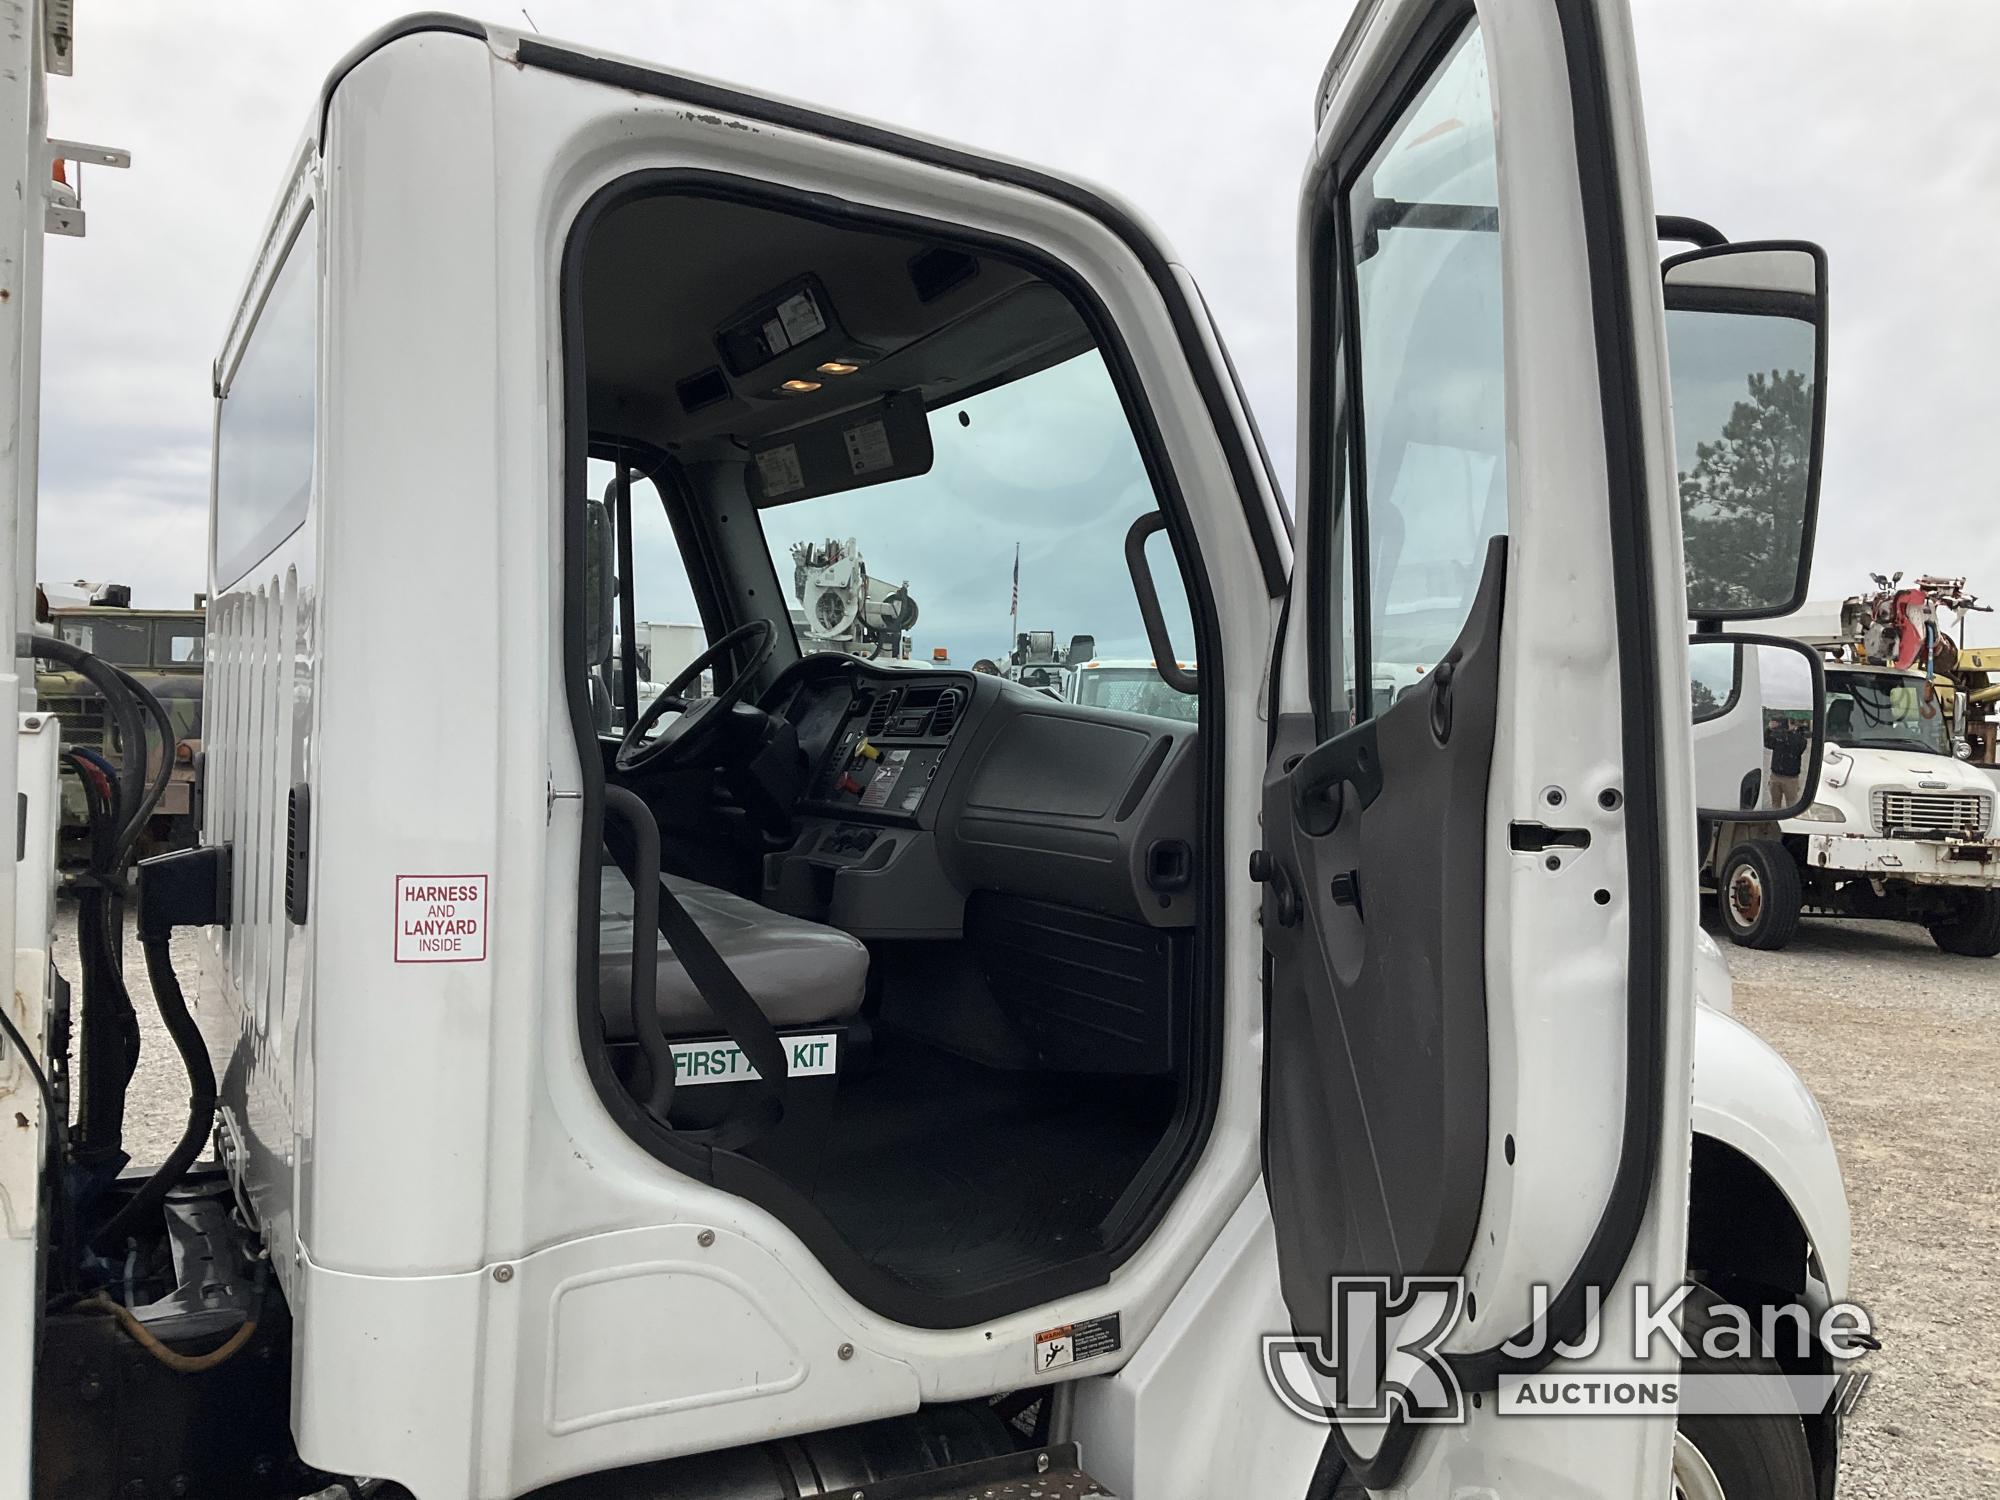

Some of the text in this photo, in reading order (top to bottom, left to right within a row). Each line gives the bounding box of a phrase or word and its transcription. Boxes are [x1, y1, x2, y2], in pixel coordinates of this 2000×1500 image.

[405, 886, 478, 901] HARNESS
[427, 904, 455, 917] AND
[404, 919, 477, 935] LANYARD
[419, 938, 462, 951] INSIDE
[673, 1042, 829, 1077] FIRST KIT
